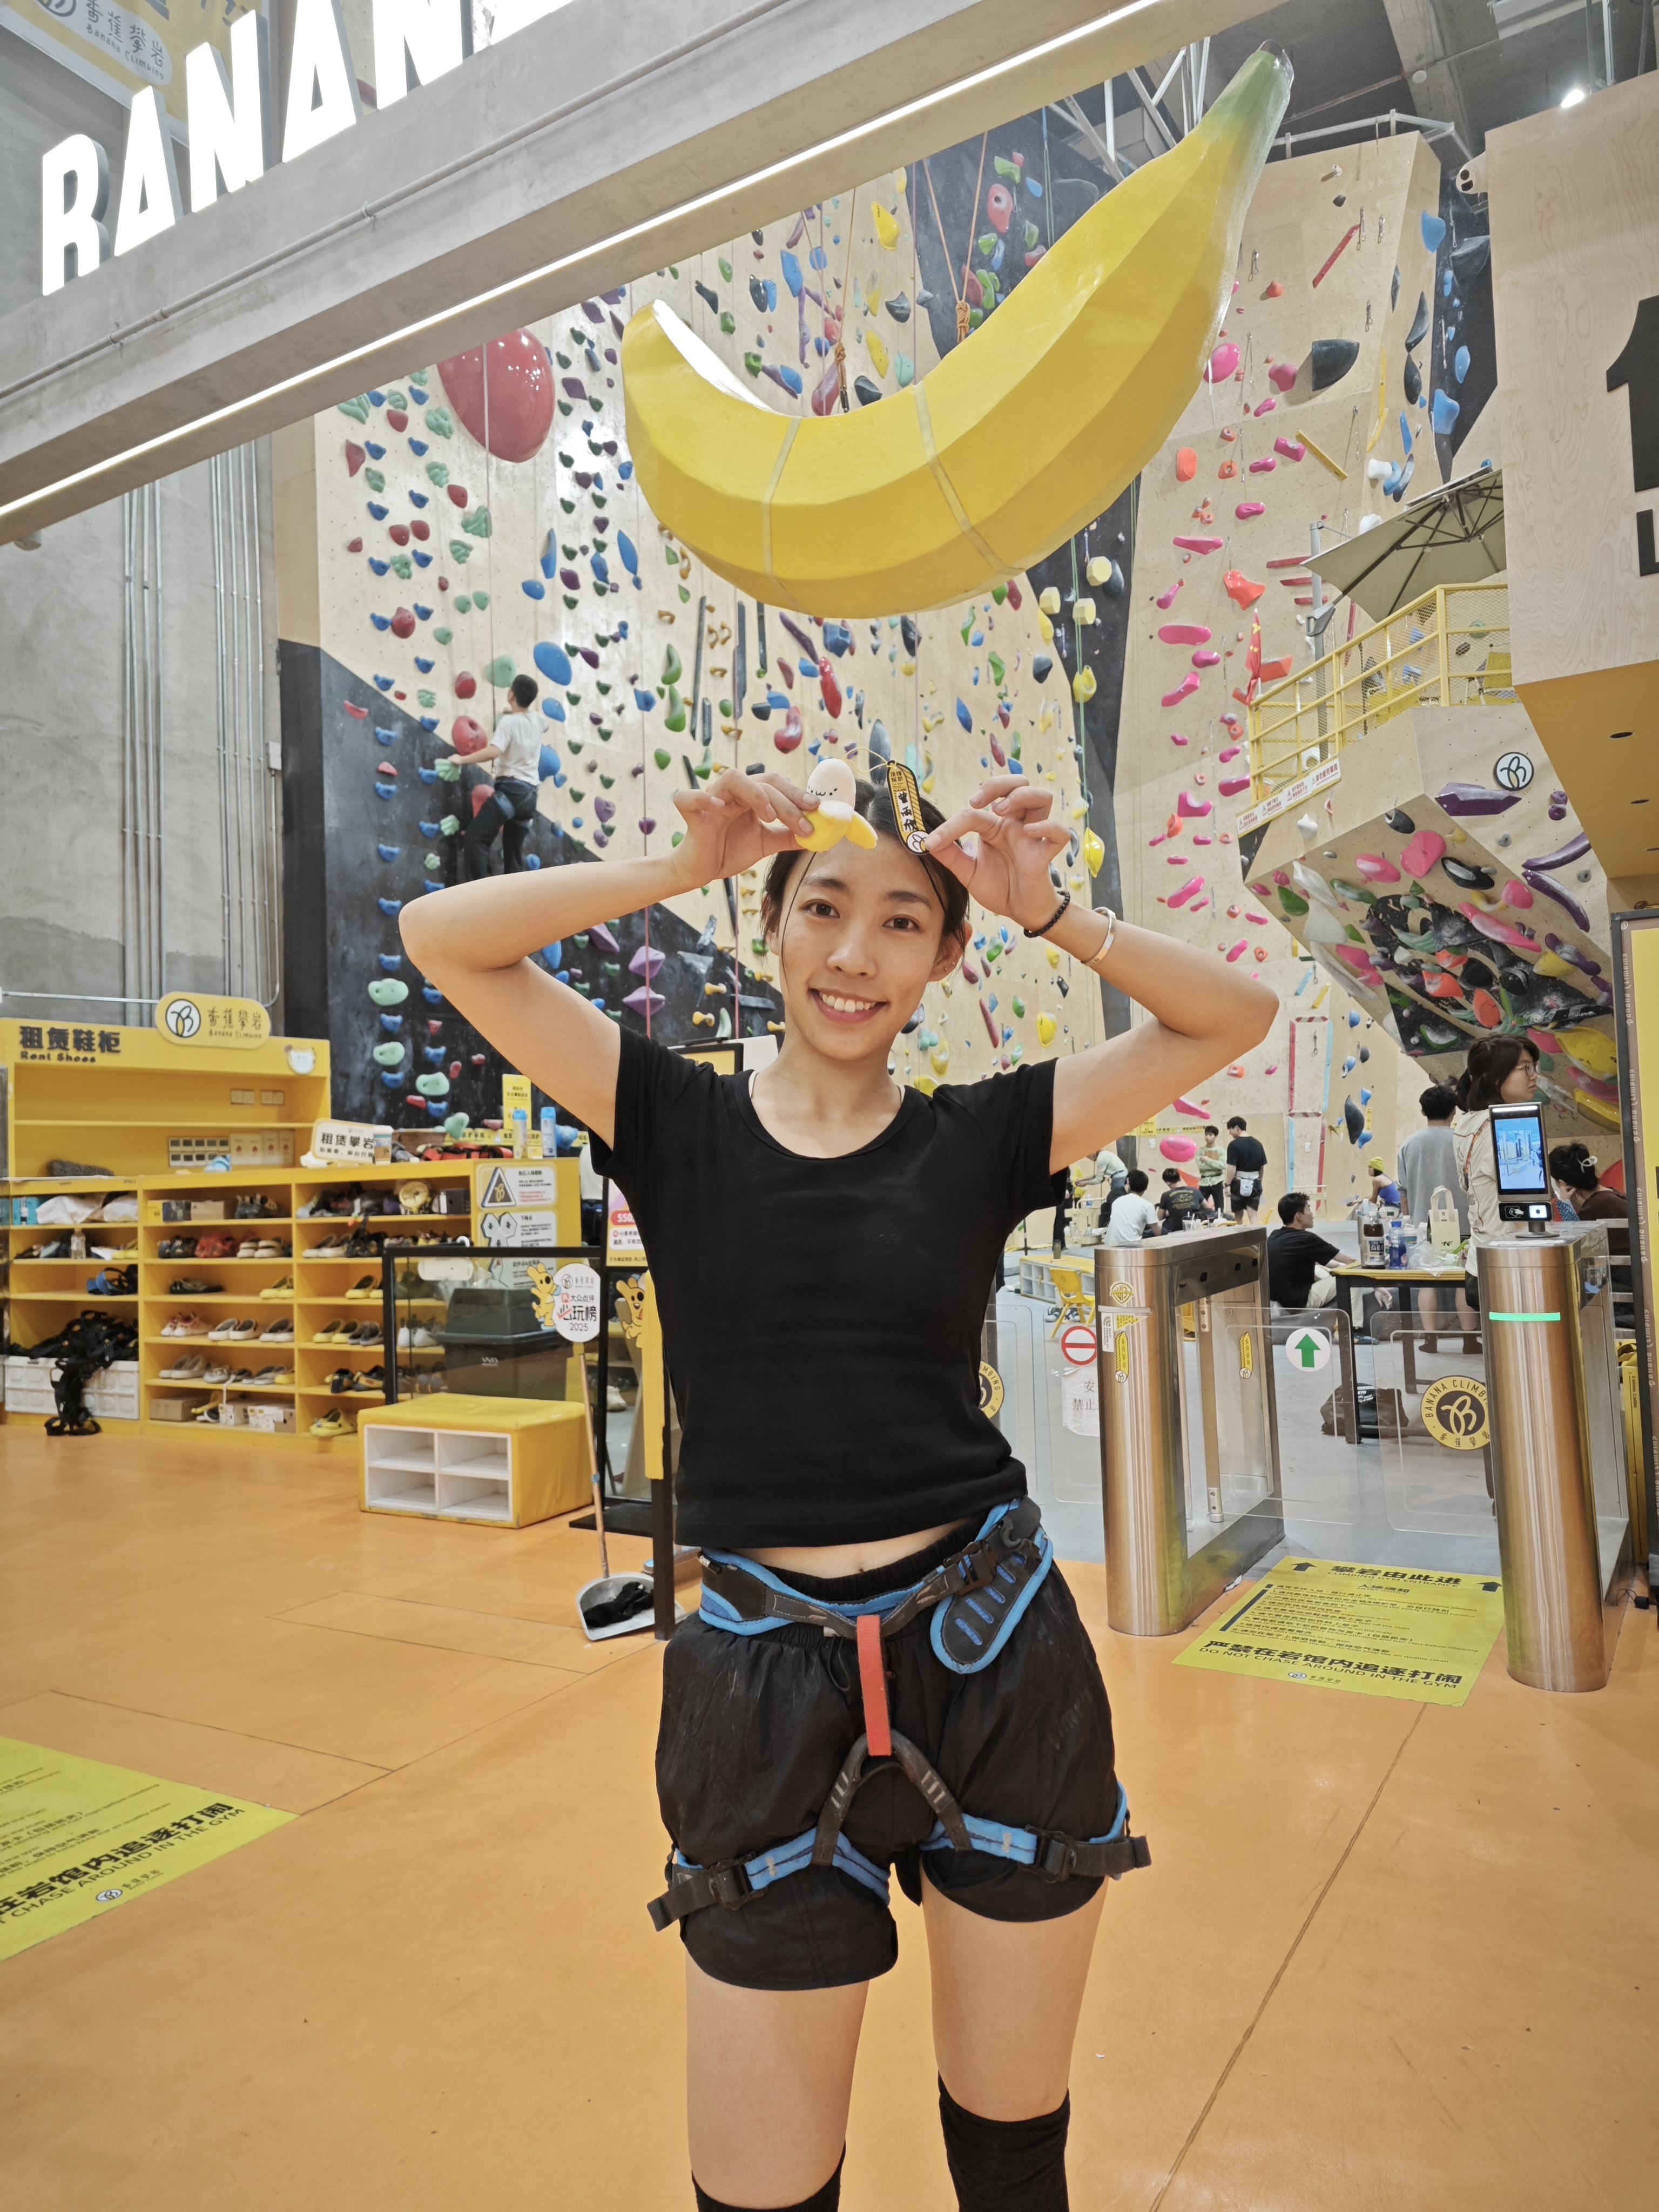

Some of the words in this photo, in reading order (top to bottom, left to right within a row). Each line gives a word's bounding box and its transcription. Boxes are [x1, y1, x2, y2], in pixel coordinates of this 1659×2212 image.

[20, 1025, 121, 1053] 租赁鞋柜
[570, 1294, 595, 1303] 大众点评
[557, 1304, 597, 1321] 必玩榜
[570, 1323, 589, 1332] 2025
[1072, 1397, 1099, 1411] 禁止
[1425, 1382, 1448, 1418] BANANA
[1330, 1565, 1462, 1586] 攀岩由此进
[1404, 1579, 1459, 1588] ENTRANCE
[1204, 1640, 1463, 1684] 严禁在岩馆内追逐打闹
[1255, 1656, 1299, 1665] CHASE
[1302, 1663, 1366, 1676] AROUND
[1392, 1676, 1419, 1684] THE
[1424, 1681, 1457, 1689] GYM
[11, 1886, 76, 1918] CHASE
[78, 1851, 153, 1888] AROUND
[153, 1840, 177, 1853] IN
[178, 1825, 210, 1842] THE
[209, 1808, 246, 1826] GYM
